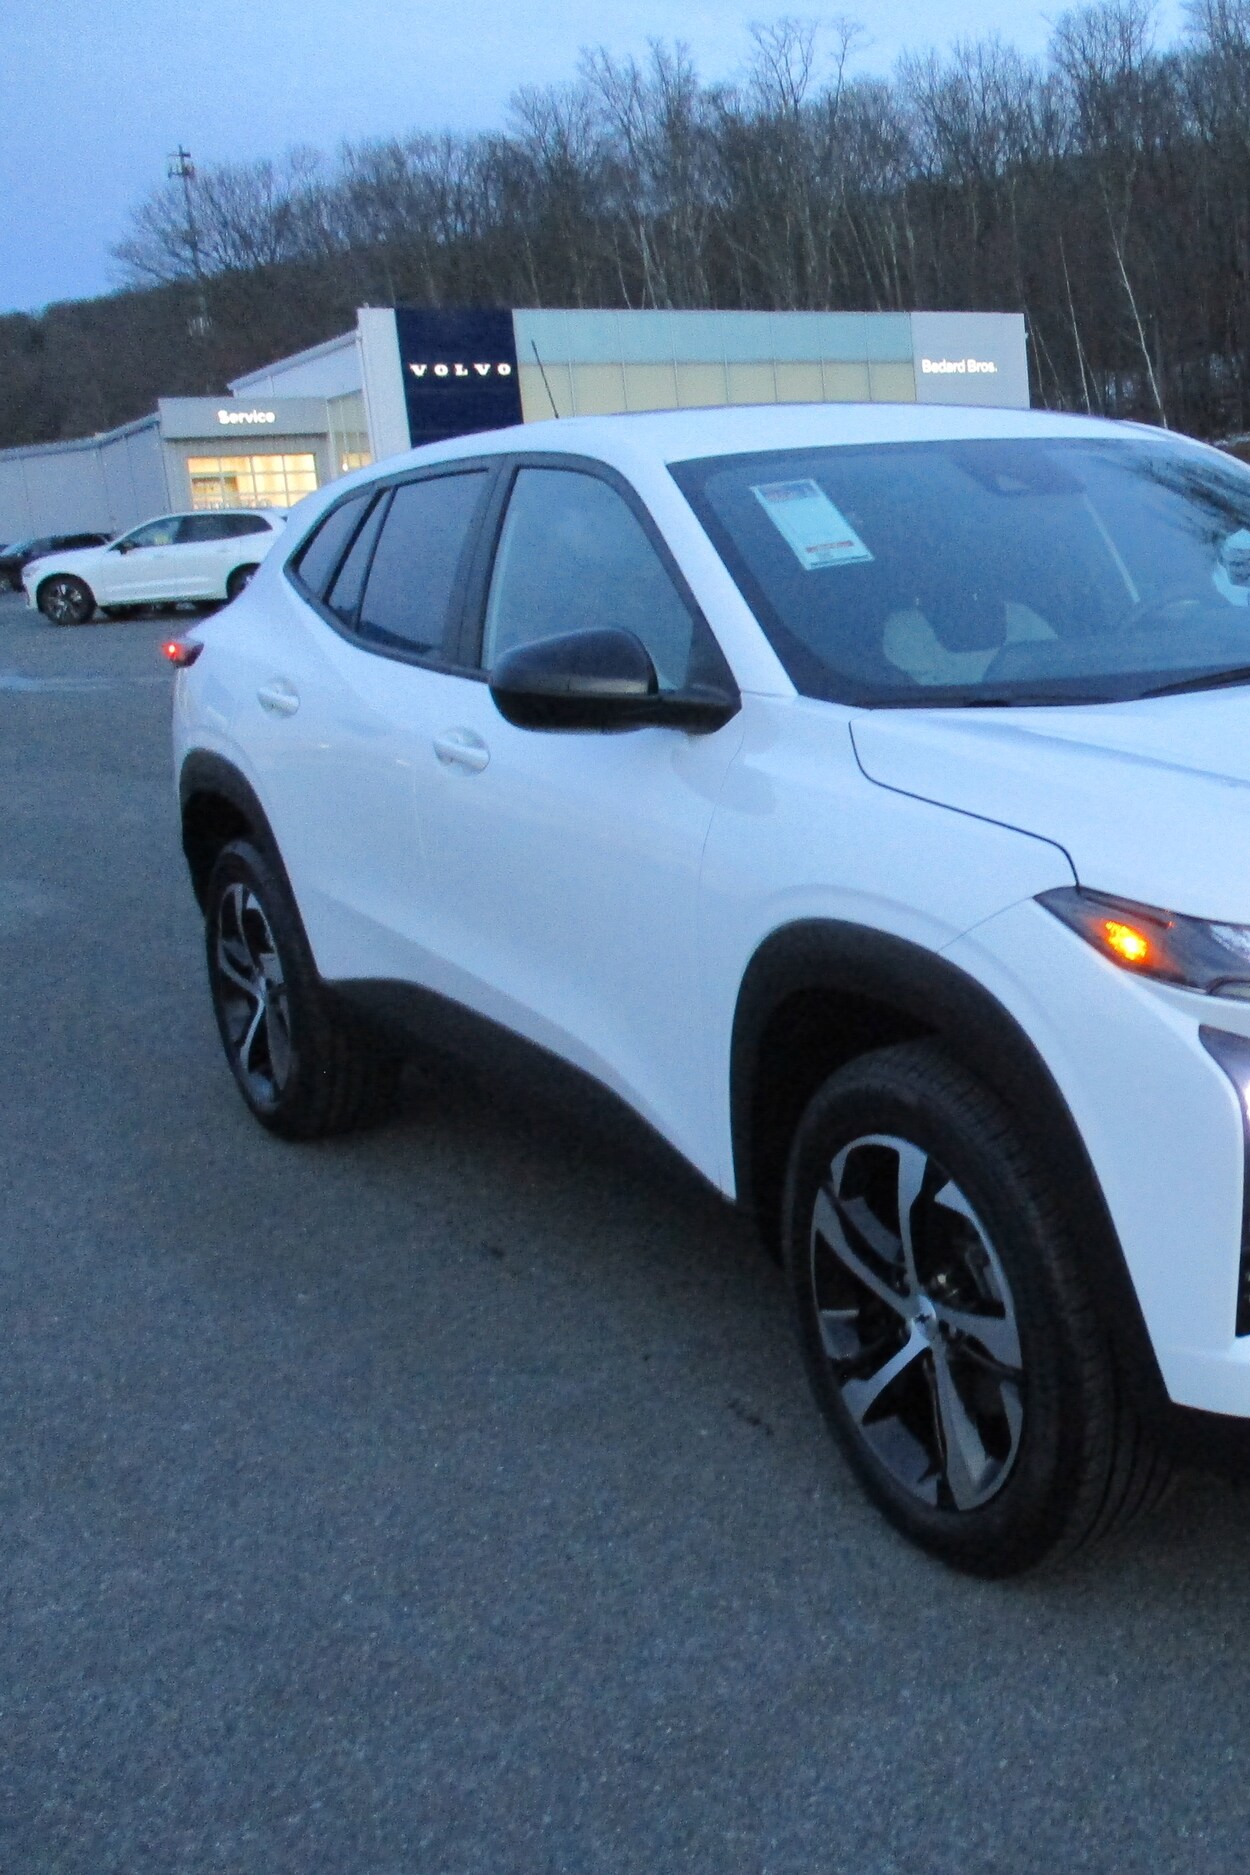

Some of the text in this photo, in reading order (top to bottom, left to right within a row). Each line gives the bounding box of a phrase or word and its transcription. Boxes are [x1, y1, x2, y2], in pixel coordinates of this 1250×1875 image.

[409, 363, 512, 377] VOLVO
[967, 359, 998, 373] Bros.
[217, 409, 276, 425] Service
